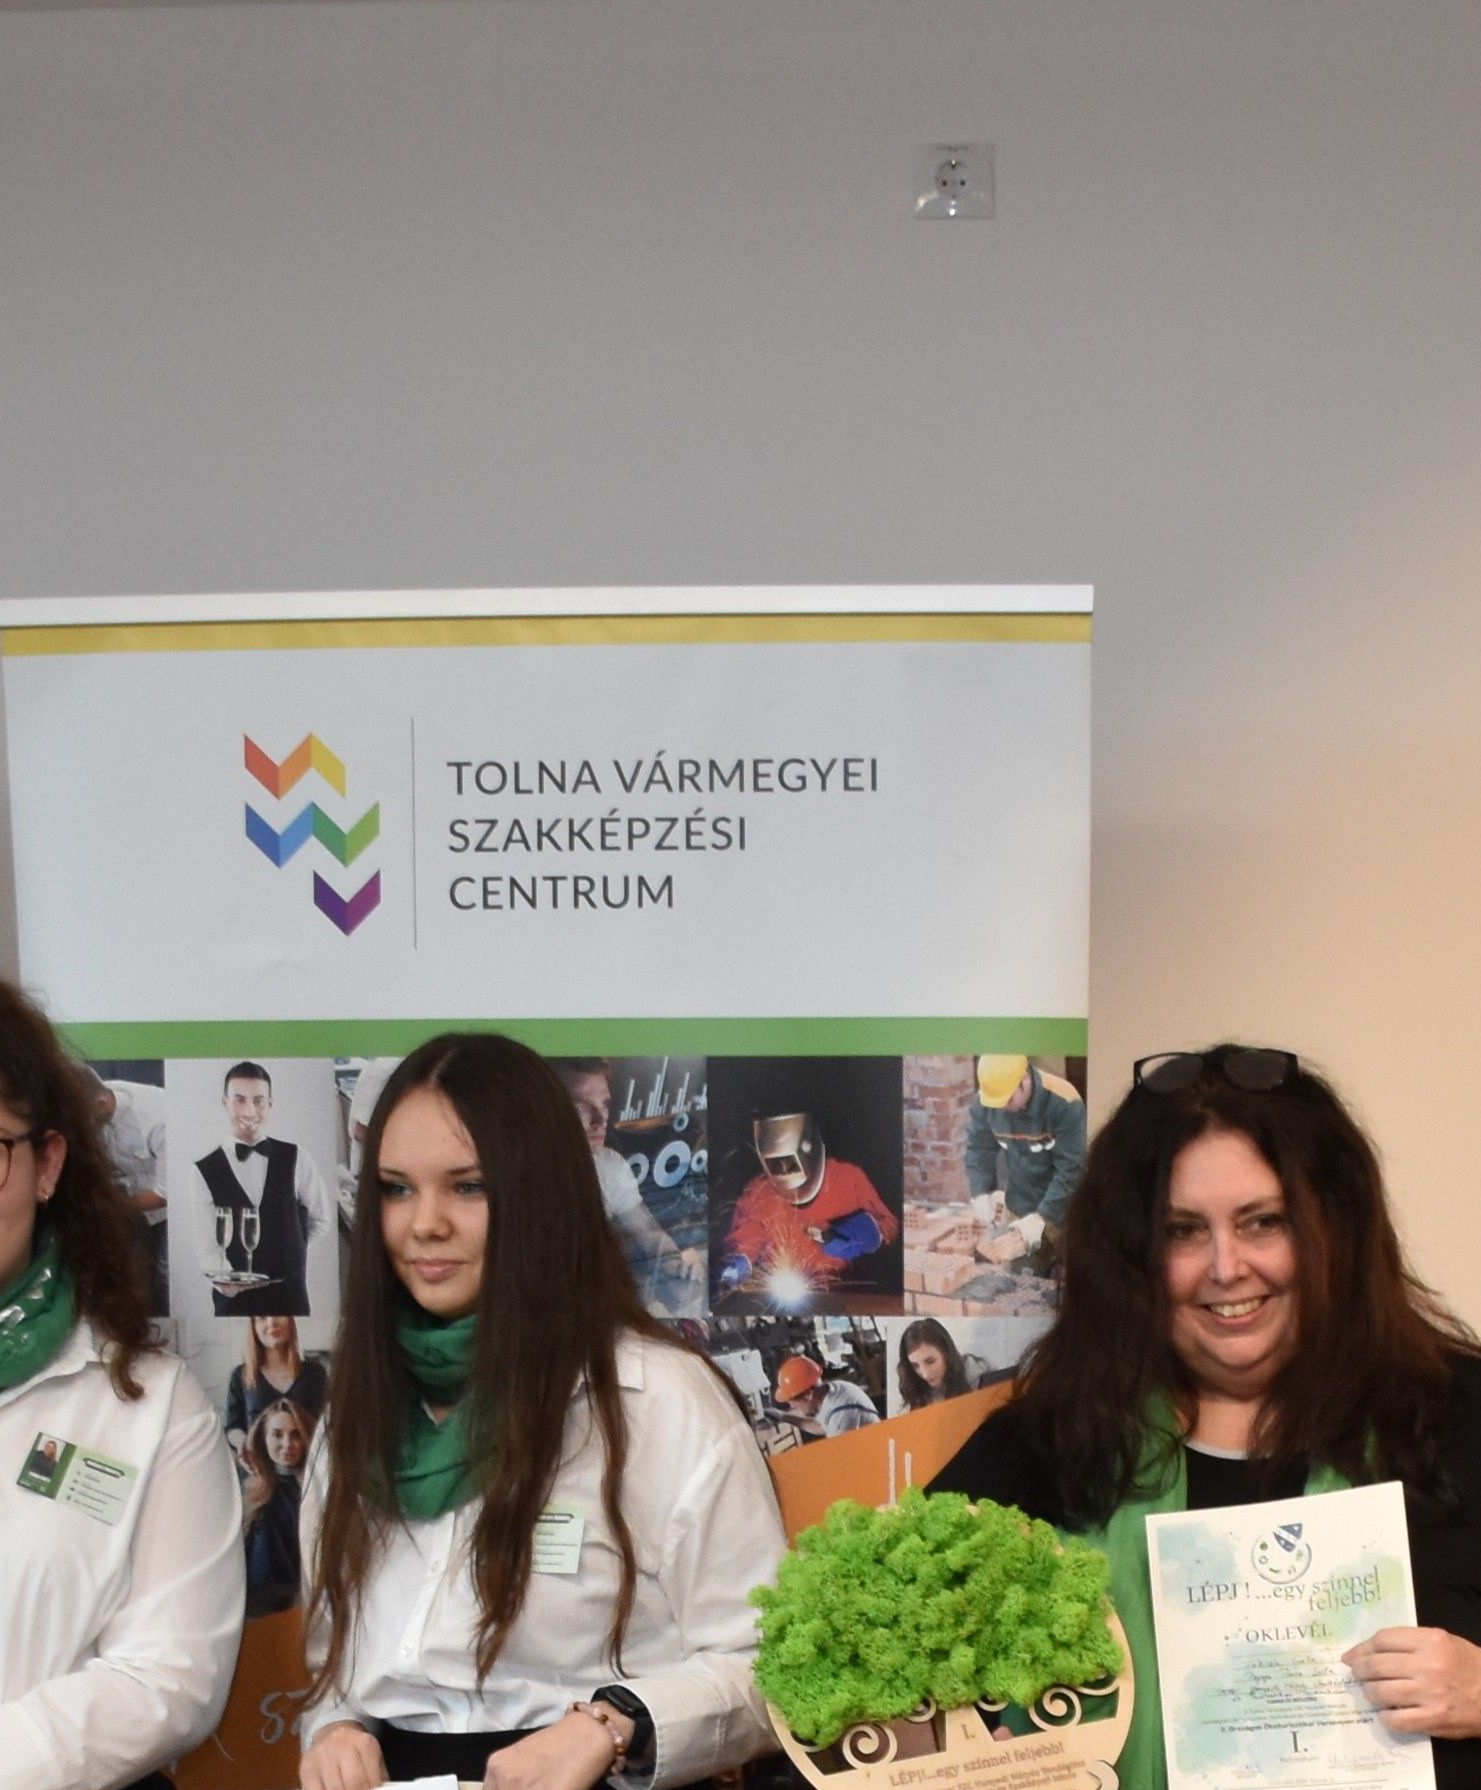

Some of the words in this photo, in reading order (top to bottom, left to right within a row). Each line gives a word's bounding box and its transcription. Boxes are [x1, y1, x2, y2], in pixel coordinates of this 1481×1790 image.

[446, 760, 602, 796] TOLNA
[612, 750, 879, 795] VÁRMEGYEI
[447, 808, 747, 854] SZAKKÉPZÉSI
[448, 874, 675, 911] CENTRUM
[1245, 1621, 1333, 1644] OKLEVÉL
